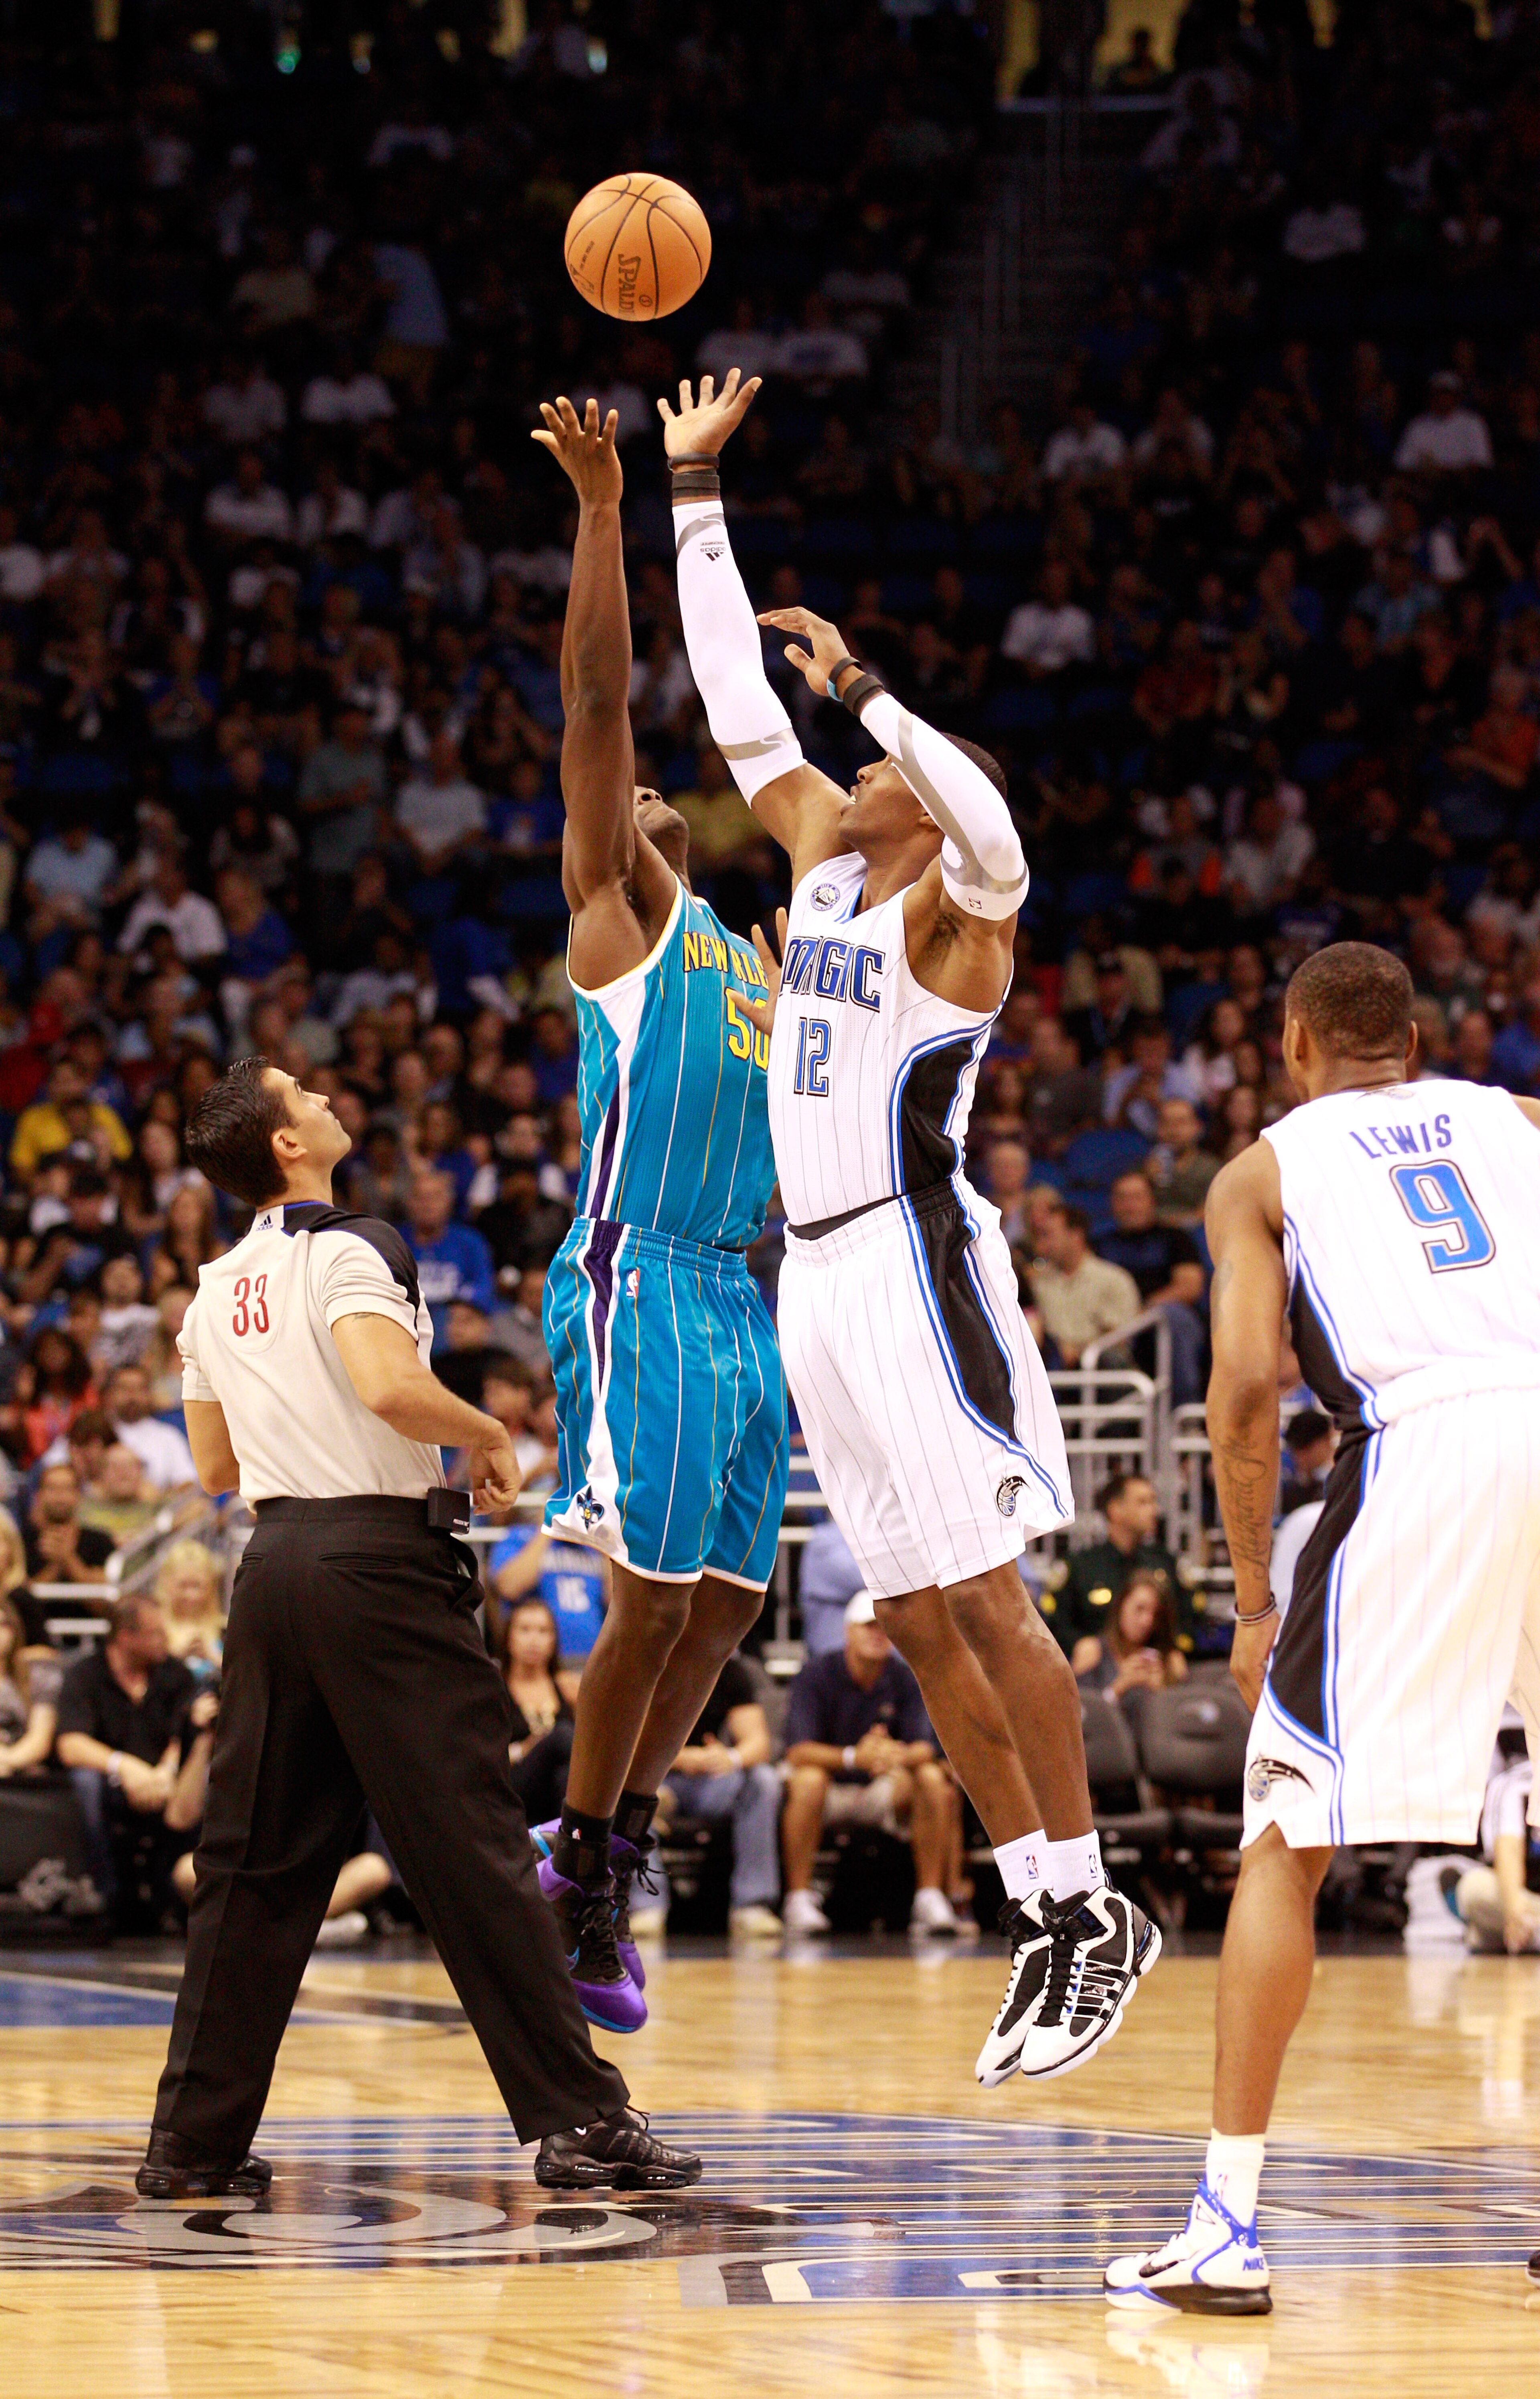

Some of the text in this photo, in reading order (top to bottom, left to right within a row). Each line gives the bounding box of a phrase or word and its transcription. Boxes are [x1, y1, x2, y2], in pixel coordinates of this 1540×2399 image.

[683, 930, 729, 973] NEW
[725, 986, 769, 1073] 50
[794, 1017, 831, 1097] 12
[1348, 1114, 1452, 1159] LEWIS
[1389, 1159, 1496, 1274] 9
[233, 1274, 270, 1337] 33
[1243, 2257, 1264, 2271] NIKE
